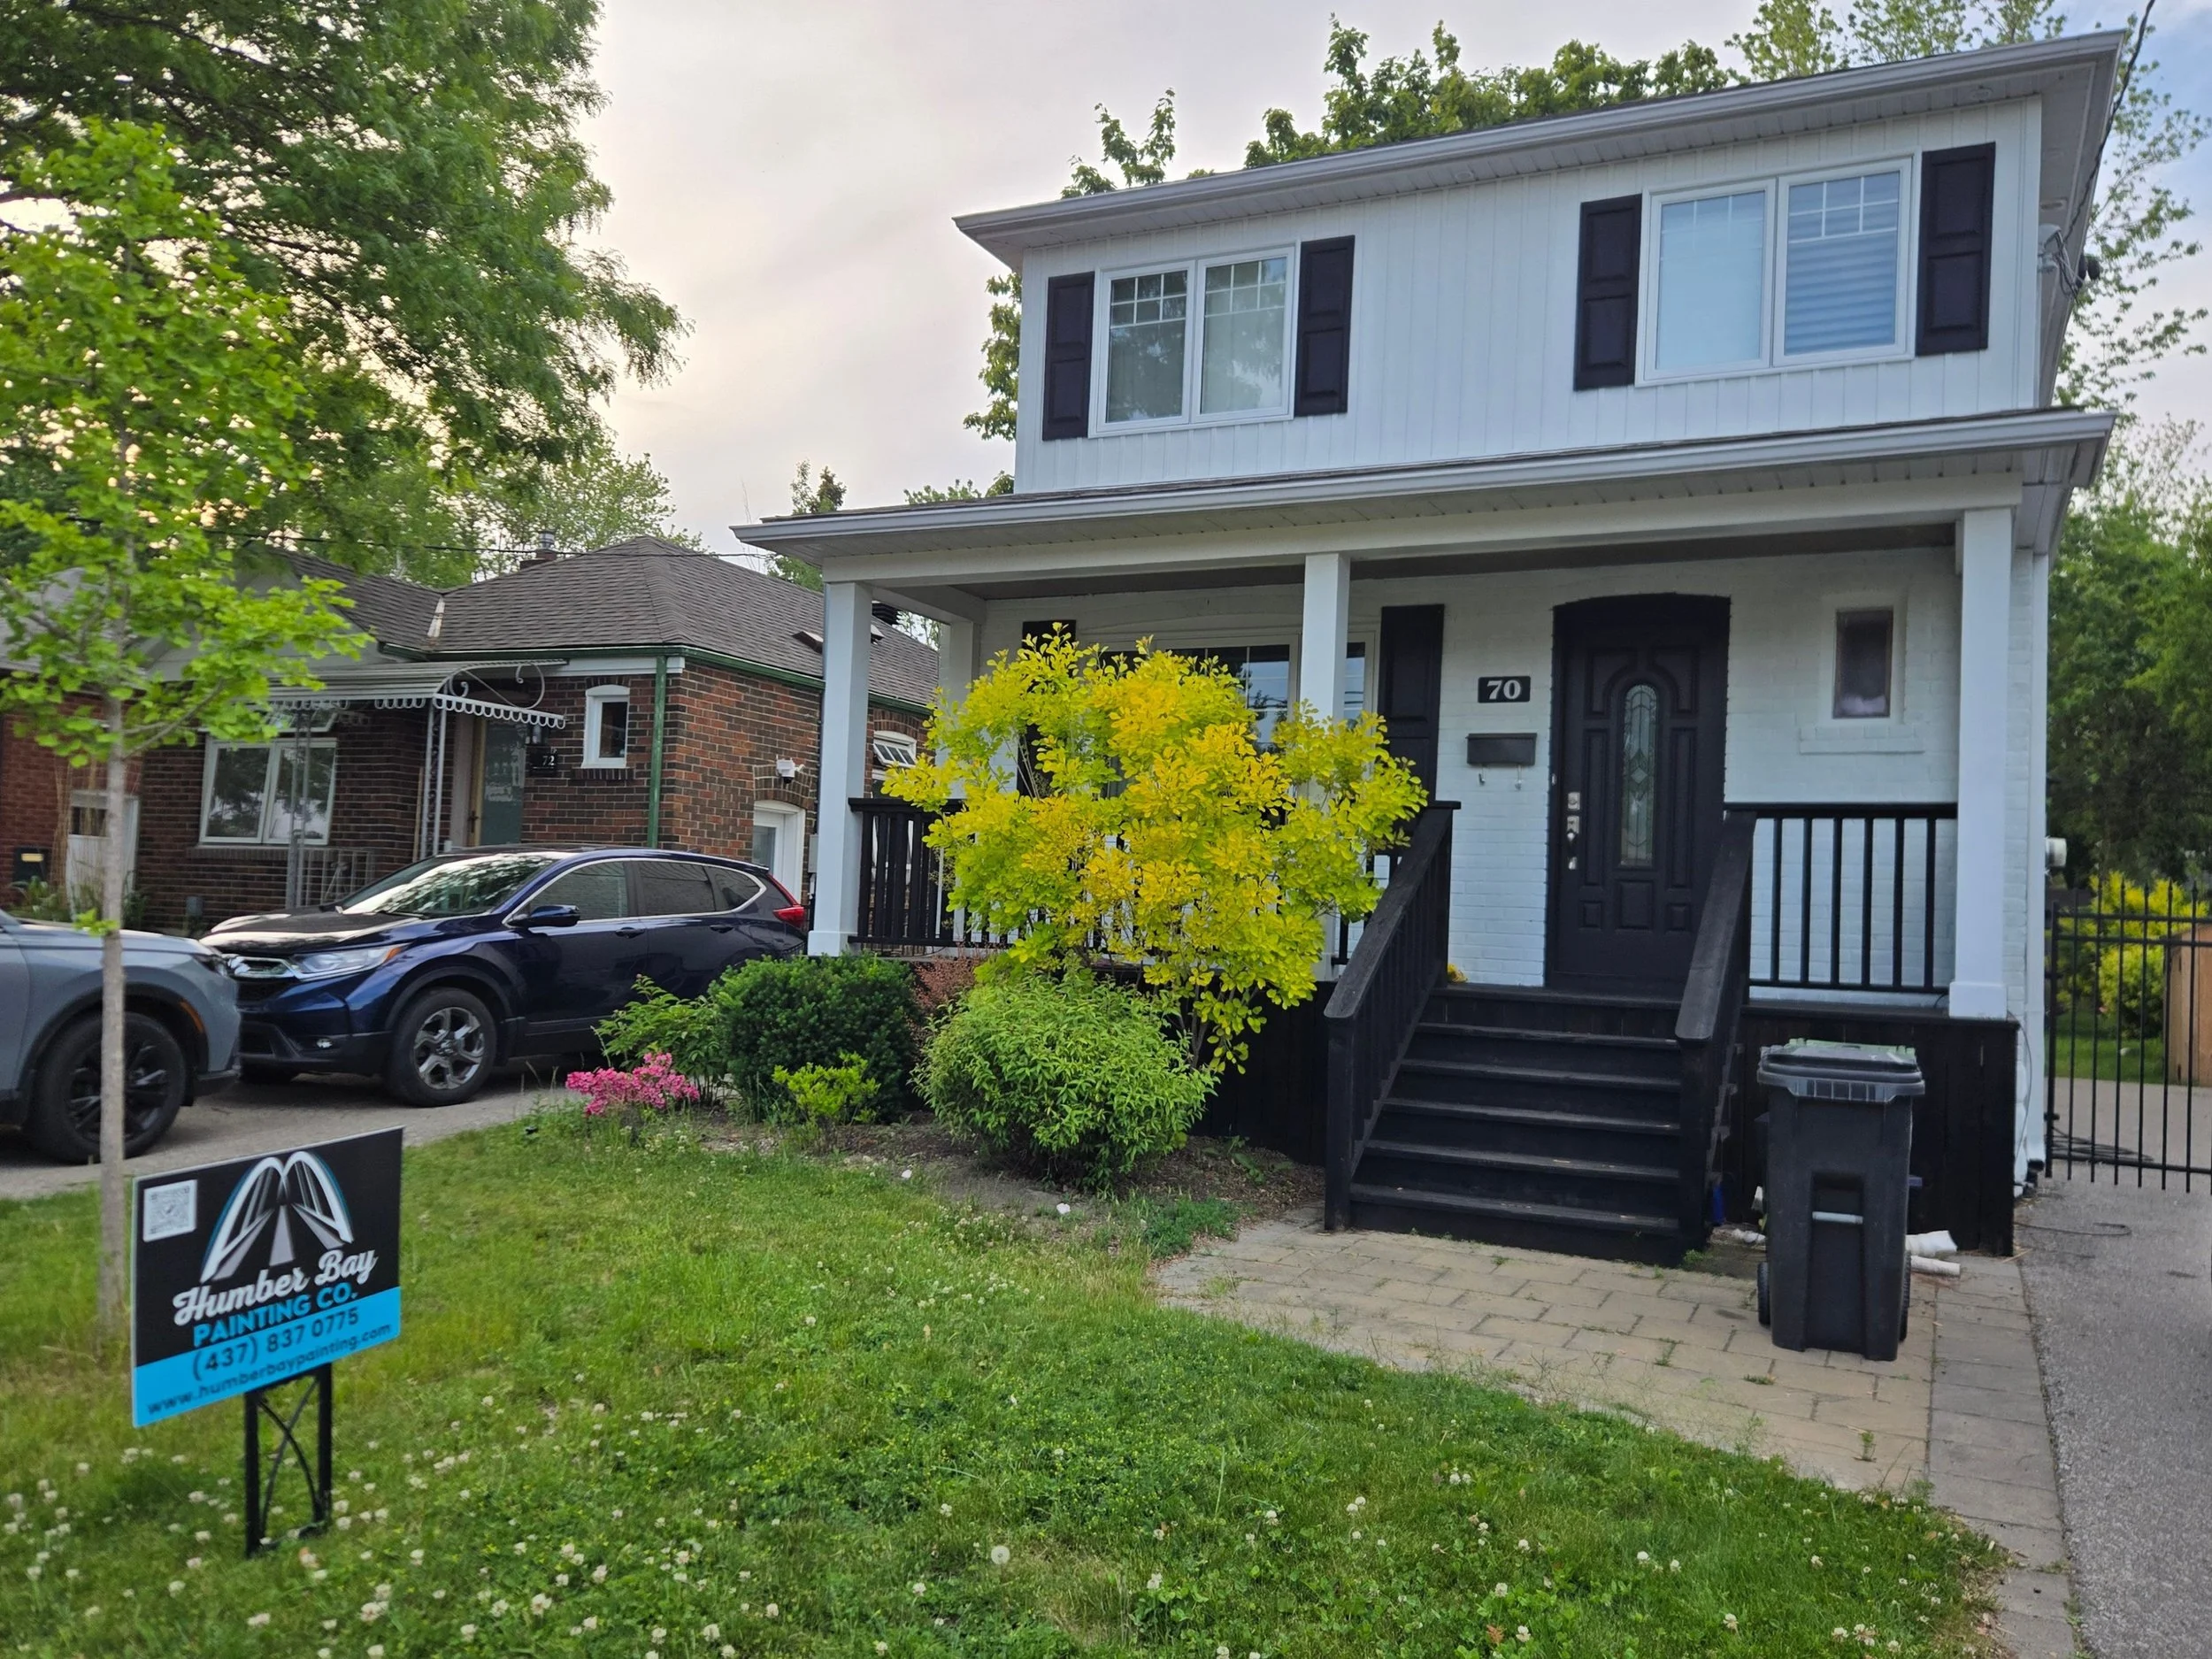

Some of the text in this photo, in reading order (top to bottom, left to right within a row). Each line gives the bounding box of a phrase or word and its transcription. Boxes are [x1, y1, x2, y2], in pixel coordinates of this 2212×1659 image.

[1486, 679, 1522, 700] 70
[173, 1248, 378, 1325] Humber Bay
[193, 1282, 357, 1348] PAINTING CO.
[148, 1324, 391, 1415] www.humberbaypainting.com
[192, 1306, 359, 1381] (437) 837 0775
